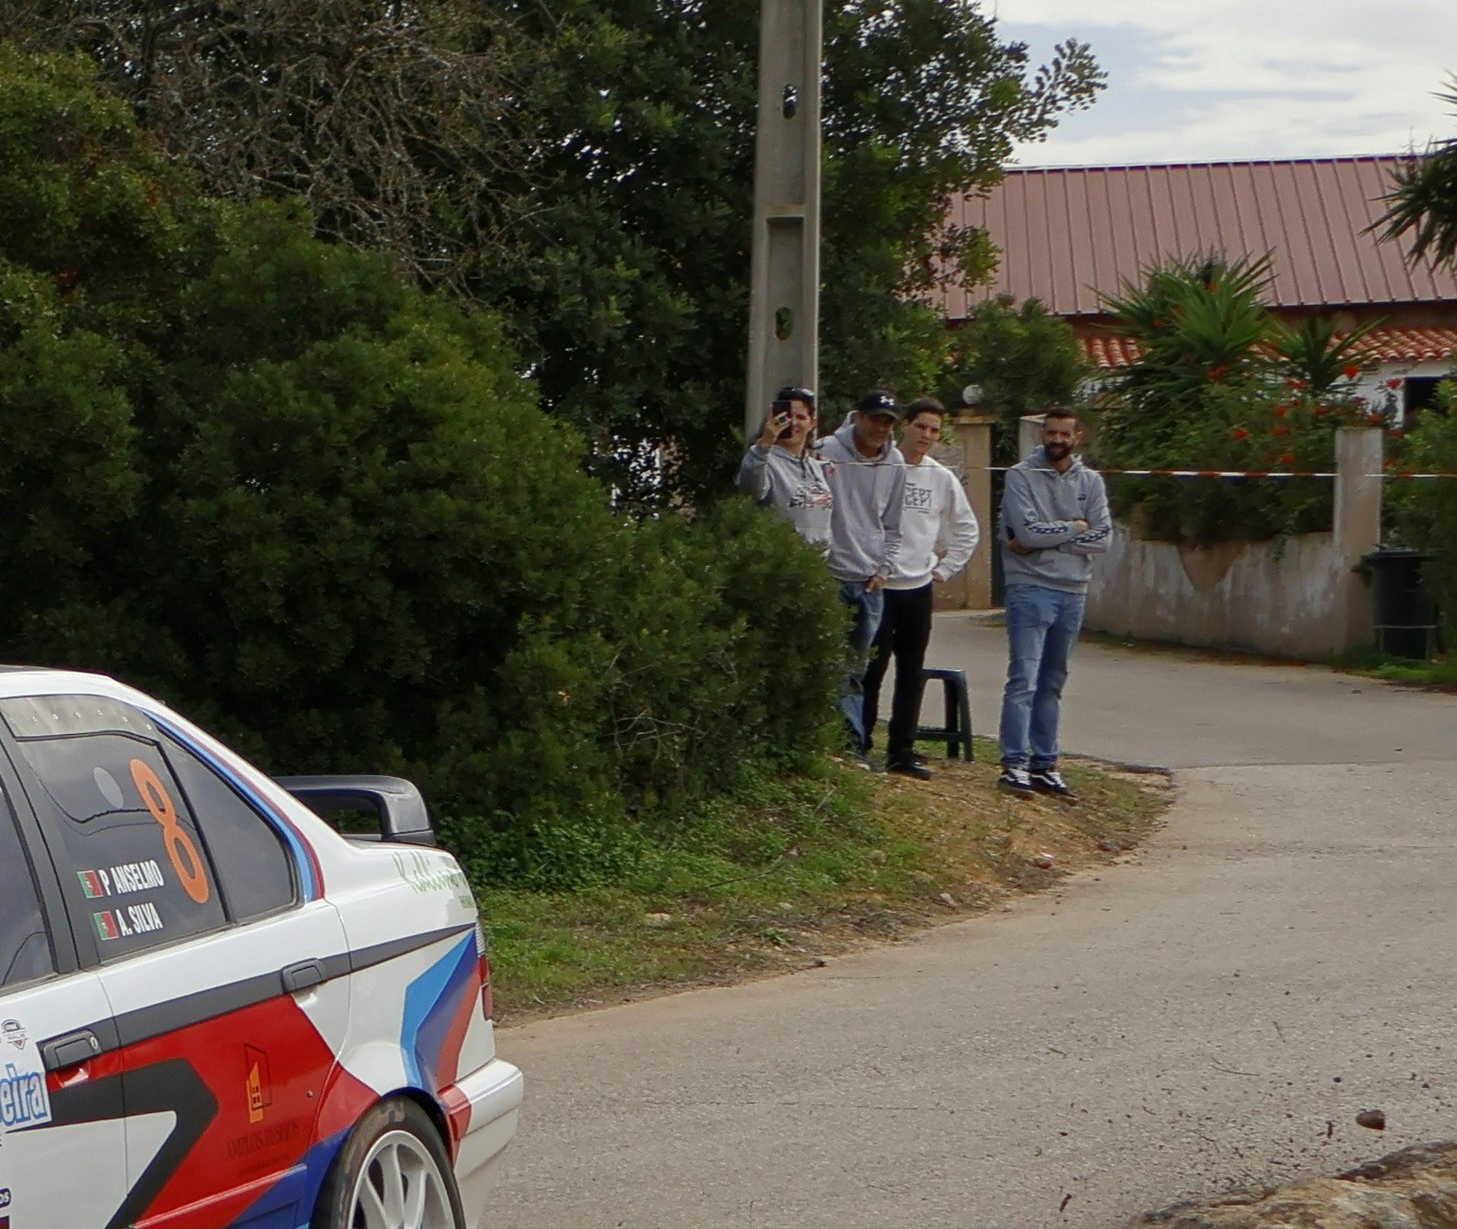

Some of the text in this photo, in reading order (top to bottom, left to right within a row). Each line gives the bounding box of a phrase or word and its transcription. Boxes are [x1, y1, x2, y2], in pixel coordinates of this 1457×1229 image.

[129, 758, 210, 904] 8
[110, 860, 165, 895] ANSELMO
[116, 902, 164, 937] A. SILVA
